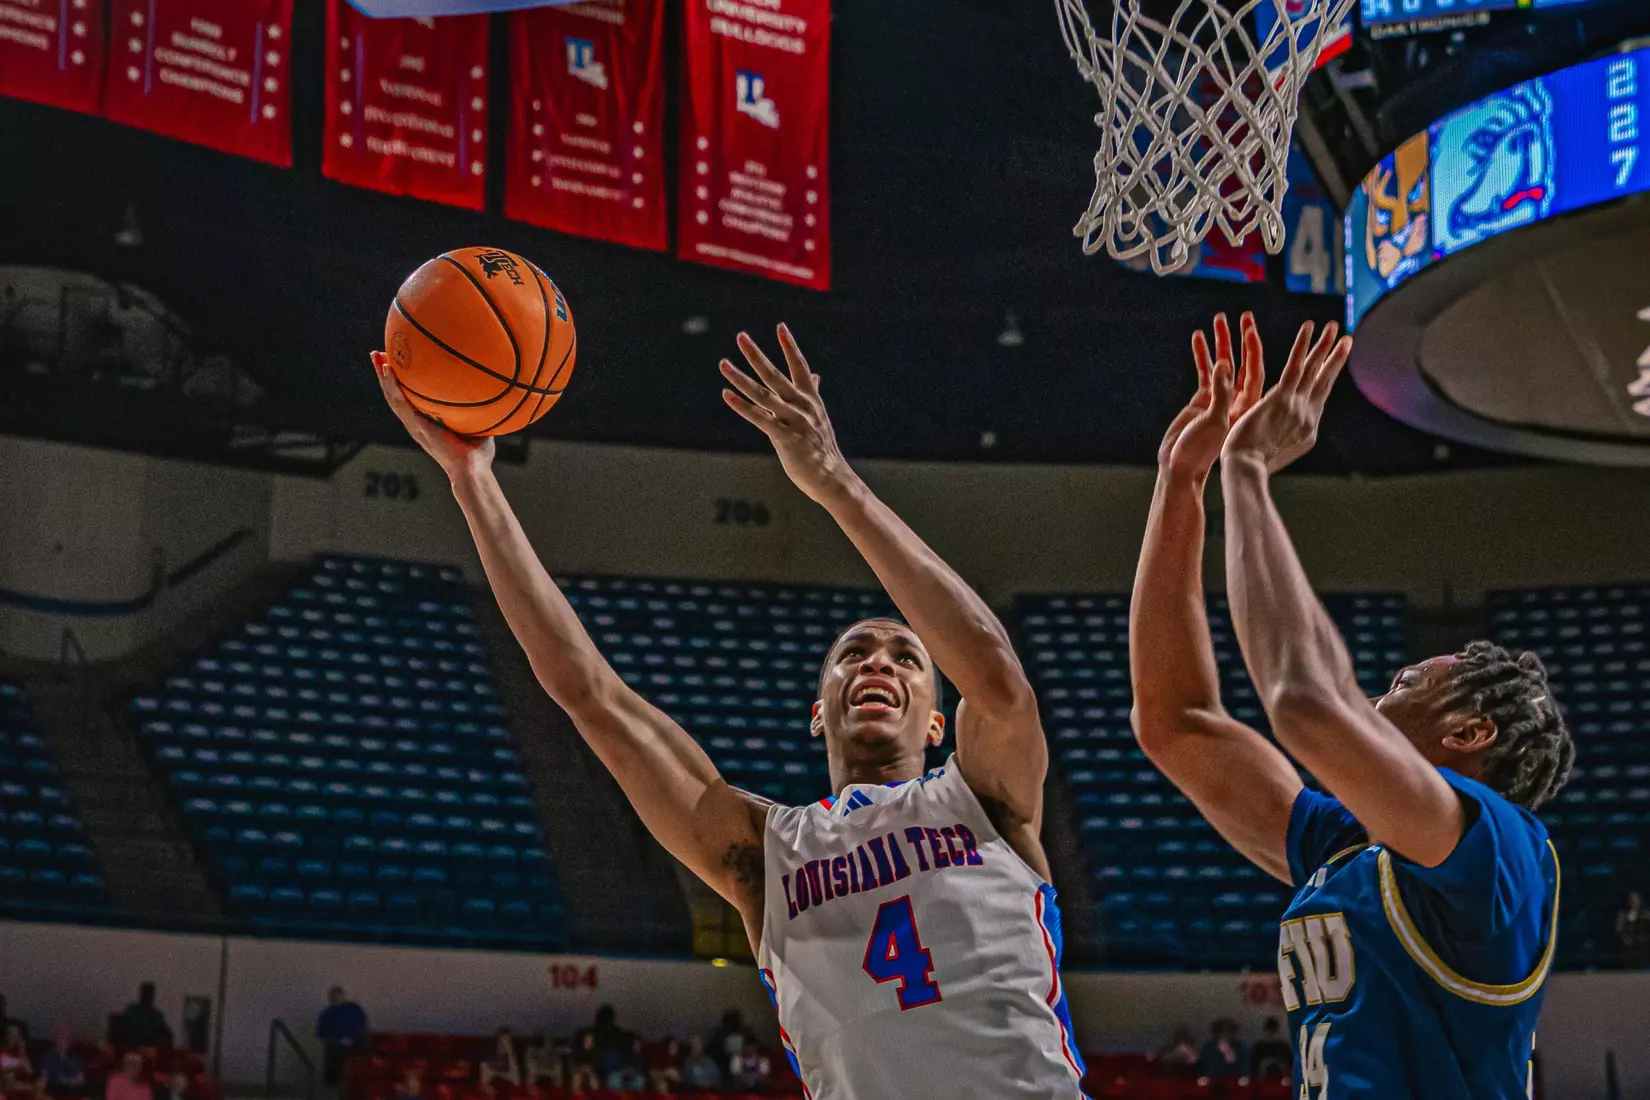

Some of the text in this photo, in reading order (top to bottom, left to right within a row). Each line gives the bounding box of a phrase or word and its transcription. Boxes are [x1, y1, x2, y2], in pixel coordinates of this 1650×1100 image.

[1608, 59, 1637, 98] 2
[1609, 103, 1638, 142] 2
[1610, 146, 1639, 187] 7
[364, 470, 419, 501] 205
[714, 499, 770, 526] 206
[782, 823, 984, 921] LOUISIANA TECH
[862, 894, 943, 1011] 4
[1277, 911, 1356, 1012] FIU
[551, 964, 598, 990] 104
